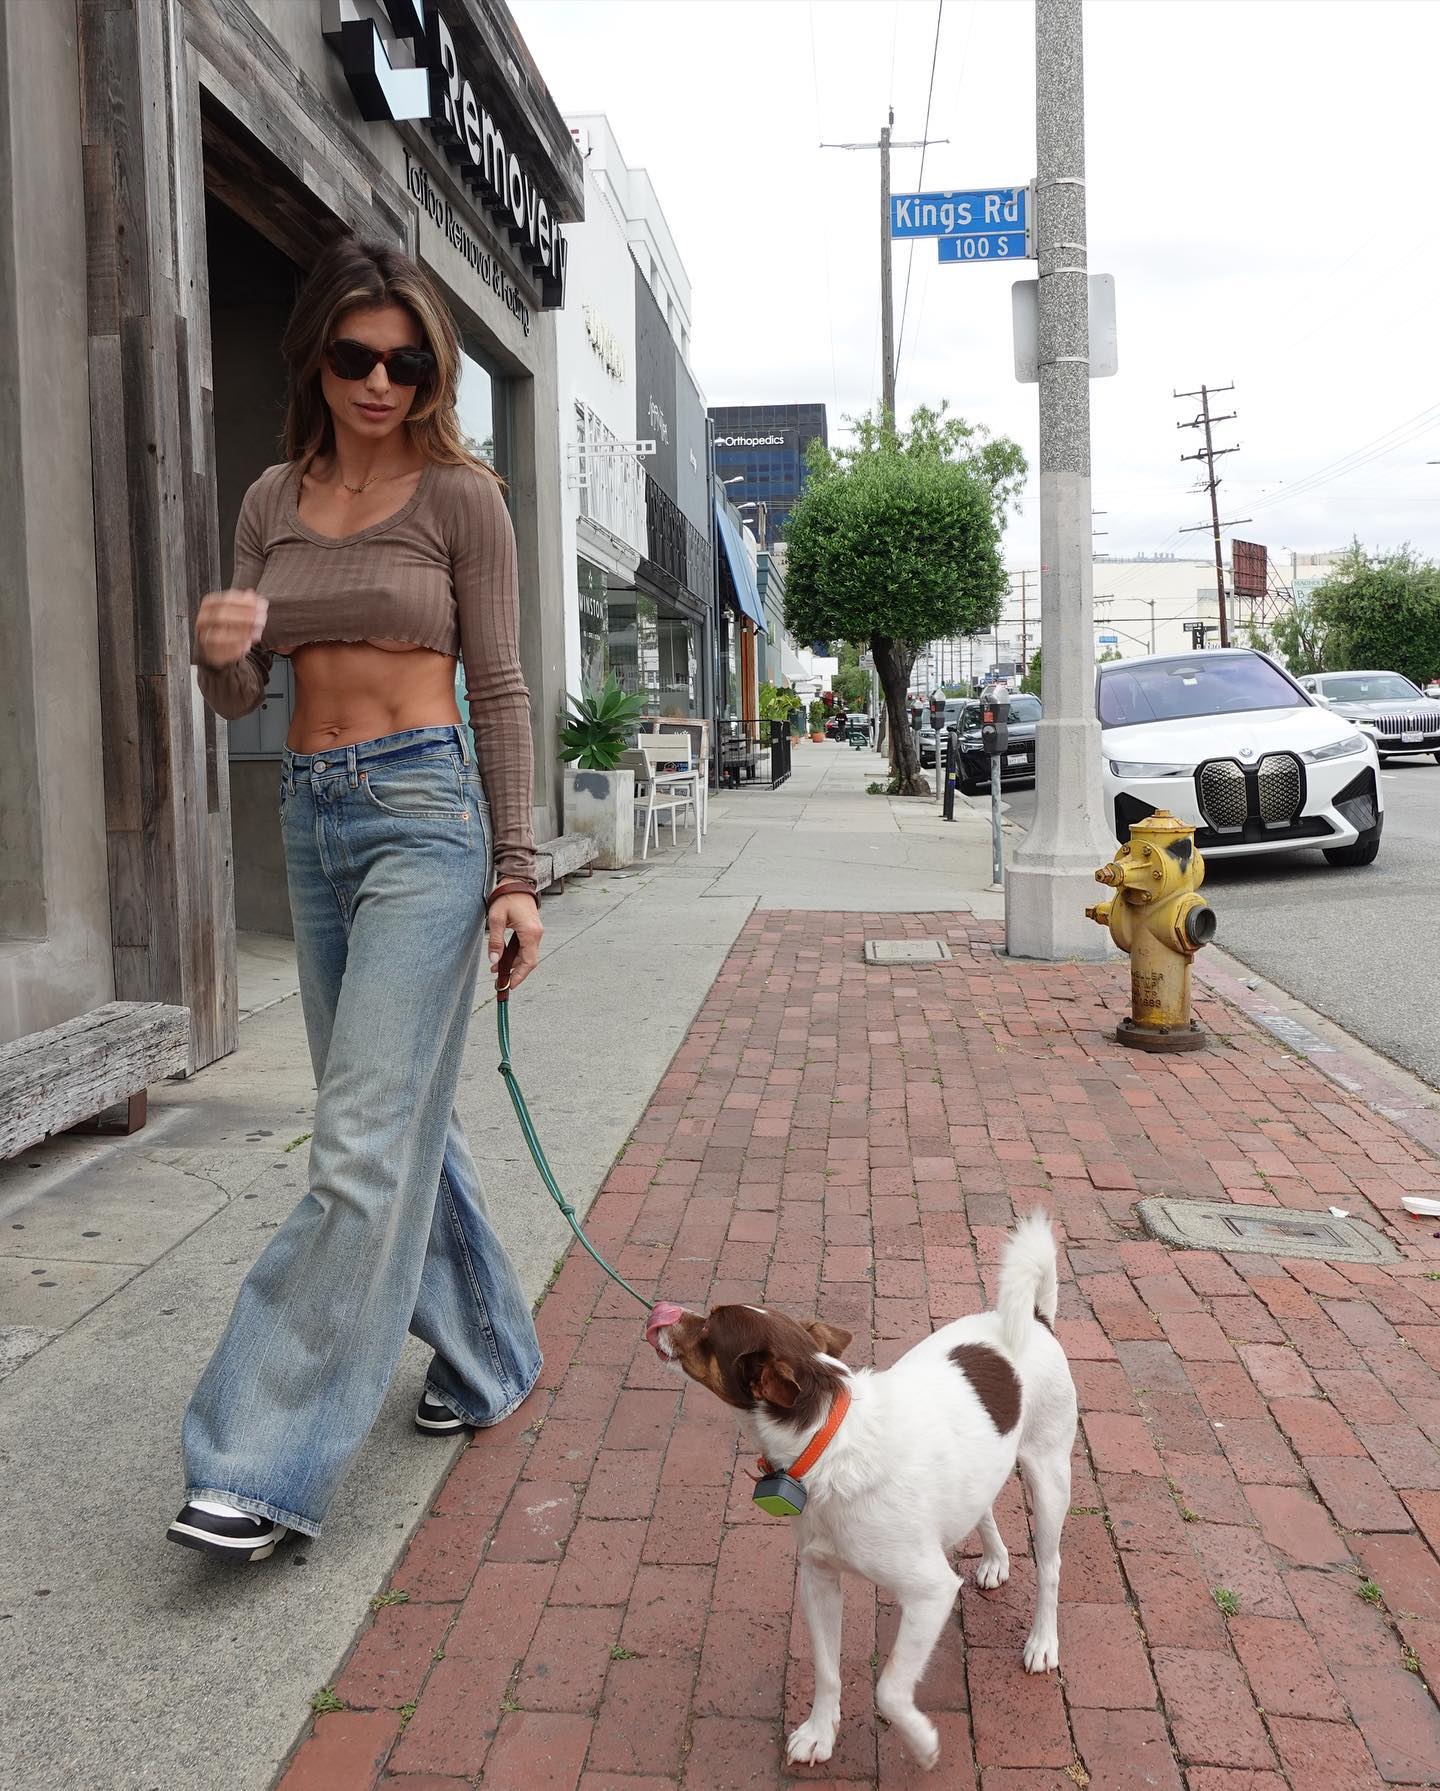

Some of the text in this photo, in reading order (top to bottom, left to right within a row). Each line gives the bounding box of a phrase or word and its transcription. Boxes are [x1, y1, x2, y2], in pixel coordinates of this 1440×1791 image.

[437, 12, 567, 309] Removery
[404, 148, 443, 228] Tattoo
[445, 201, 491, 286] Removal
[492, 261, 501, 298] &
[896, 190, 1018, 233] Kings Rd
[955, 236, 1009, 258] 100 S
[725, 435, 784, 447] Orthopedics
